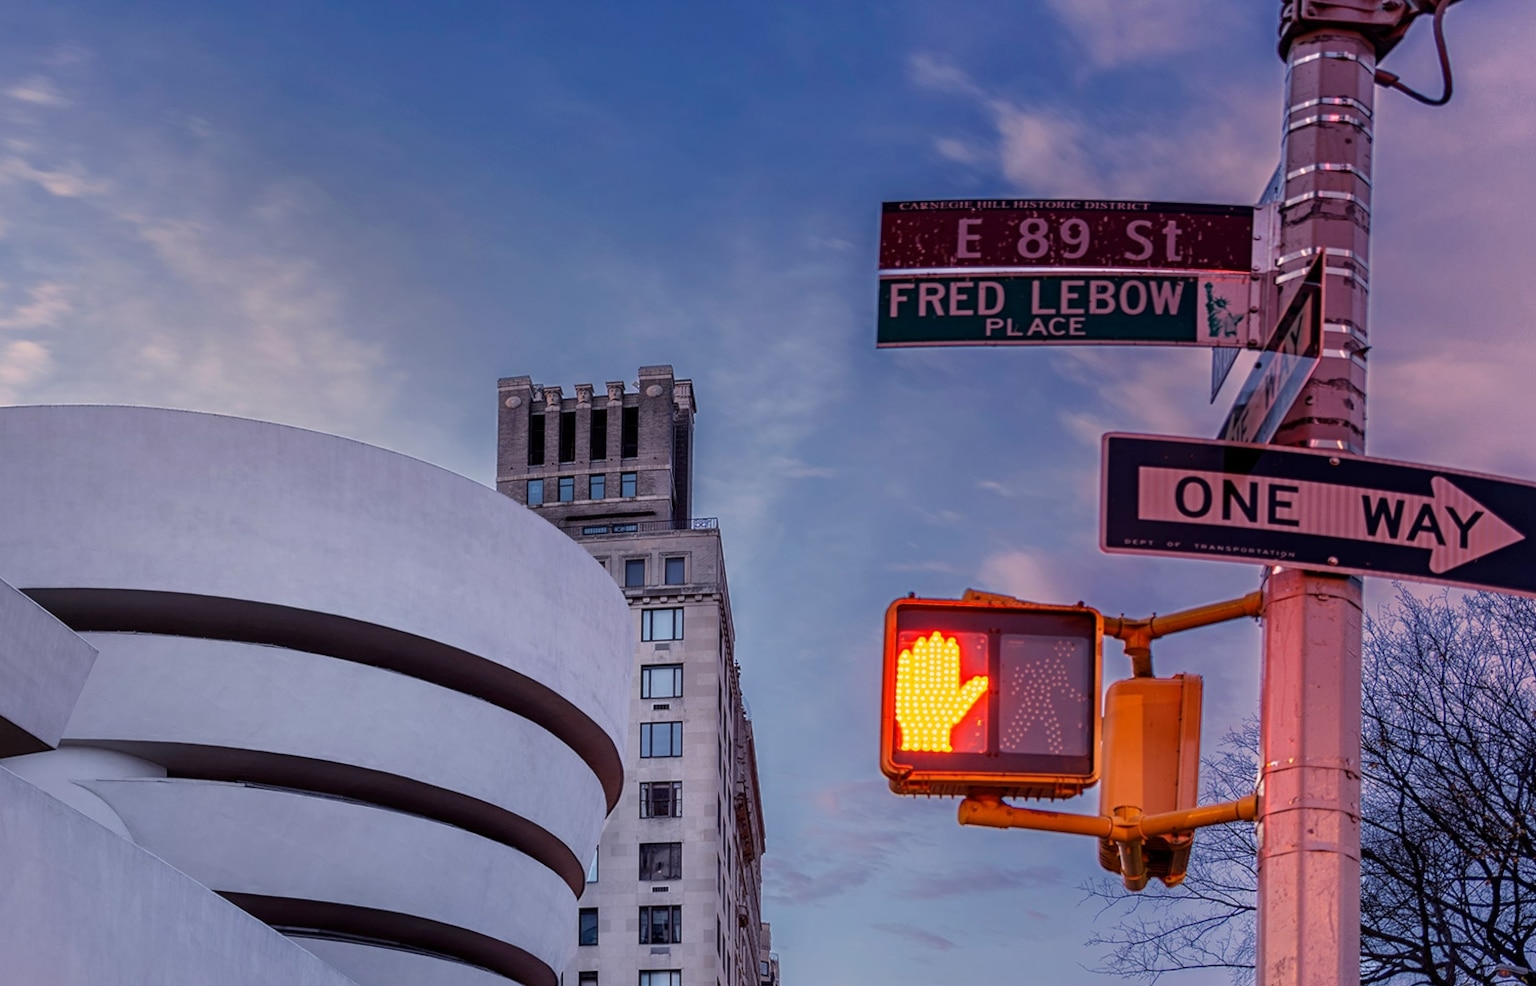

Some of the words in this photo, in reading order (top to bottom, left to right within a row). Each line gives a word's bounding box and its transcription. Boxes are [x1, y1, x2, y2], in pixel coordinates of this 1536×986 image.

[899, 201, 973, 210] CARNEGIE
[977, 201, 1010, 209] HILL
[1014, 200, 1081, 209] HISTORIC
[1084, 201, 1151, 210] DISTRICT
[956, 218, 984, 259] E
[1017, 218, 1090, 260] 89
[1124, 220, 1182, 262] St
[889, 281, 1005, 318] FRED
[1031, 280, 1184, 316] LEBOW
[985, 318, 1086, 336] PLACE
[1174, 476, 1300, 528] ONE
[1361, 494, 1484, 550] WAY
[1194, 543, 1296, 558] TRANSPORTATION
